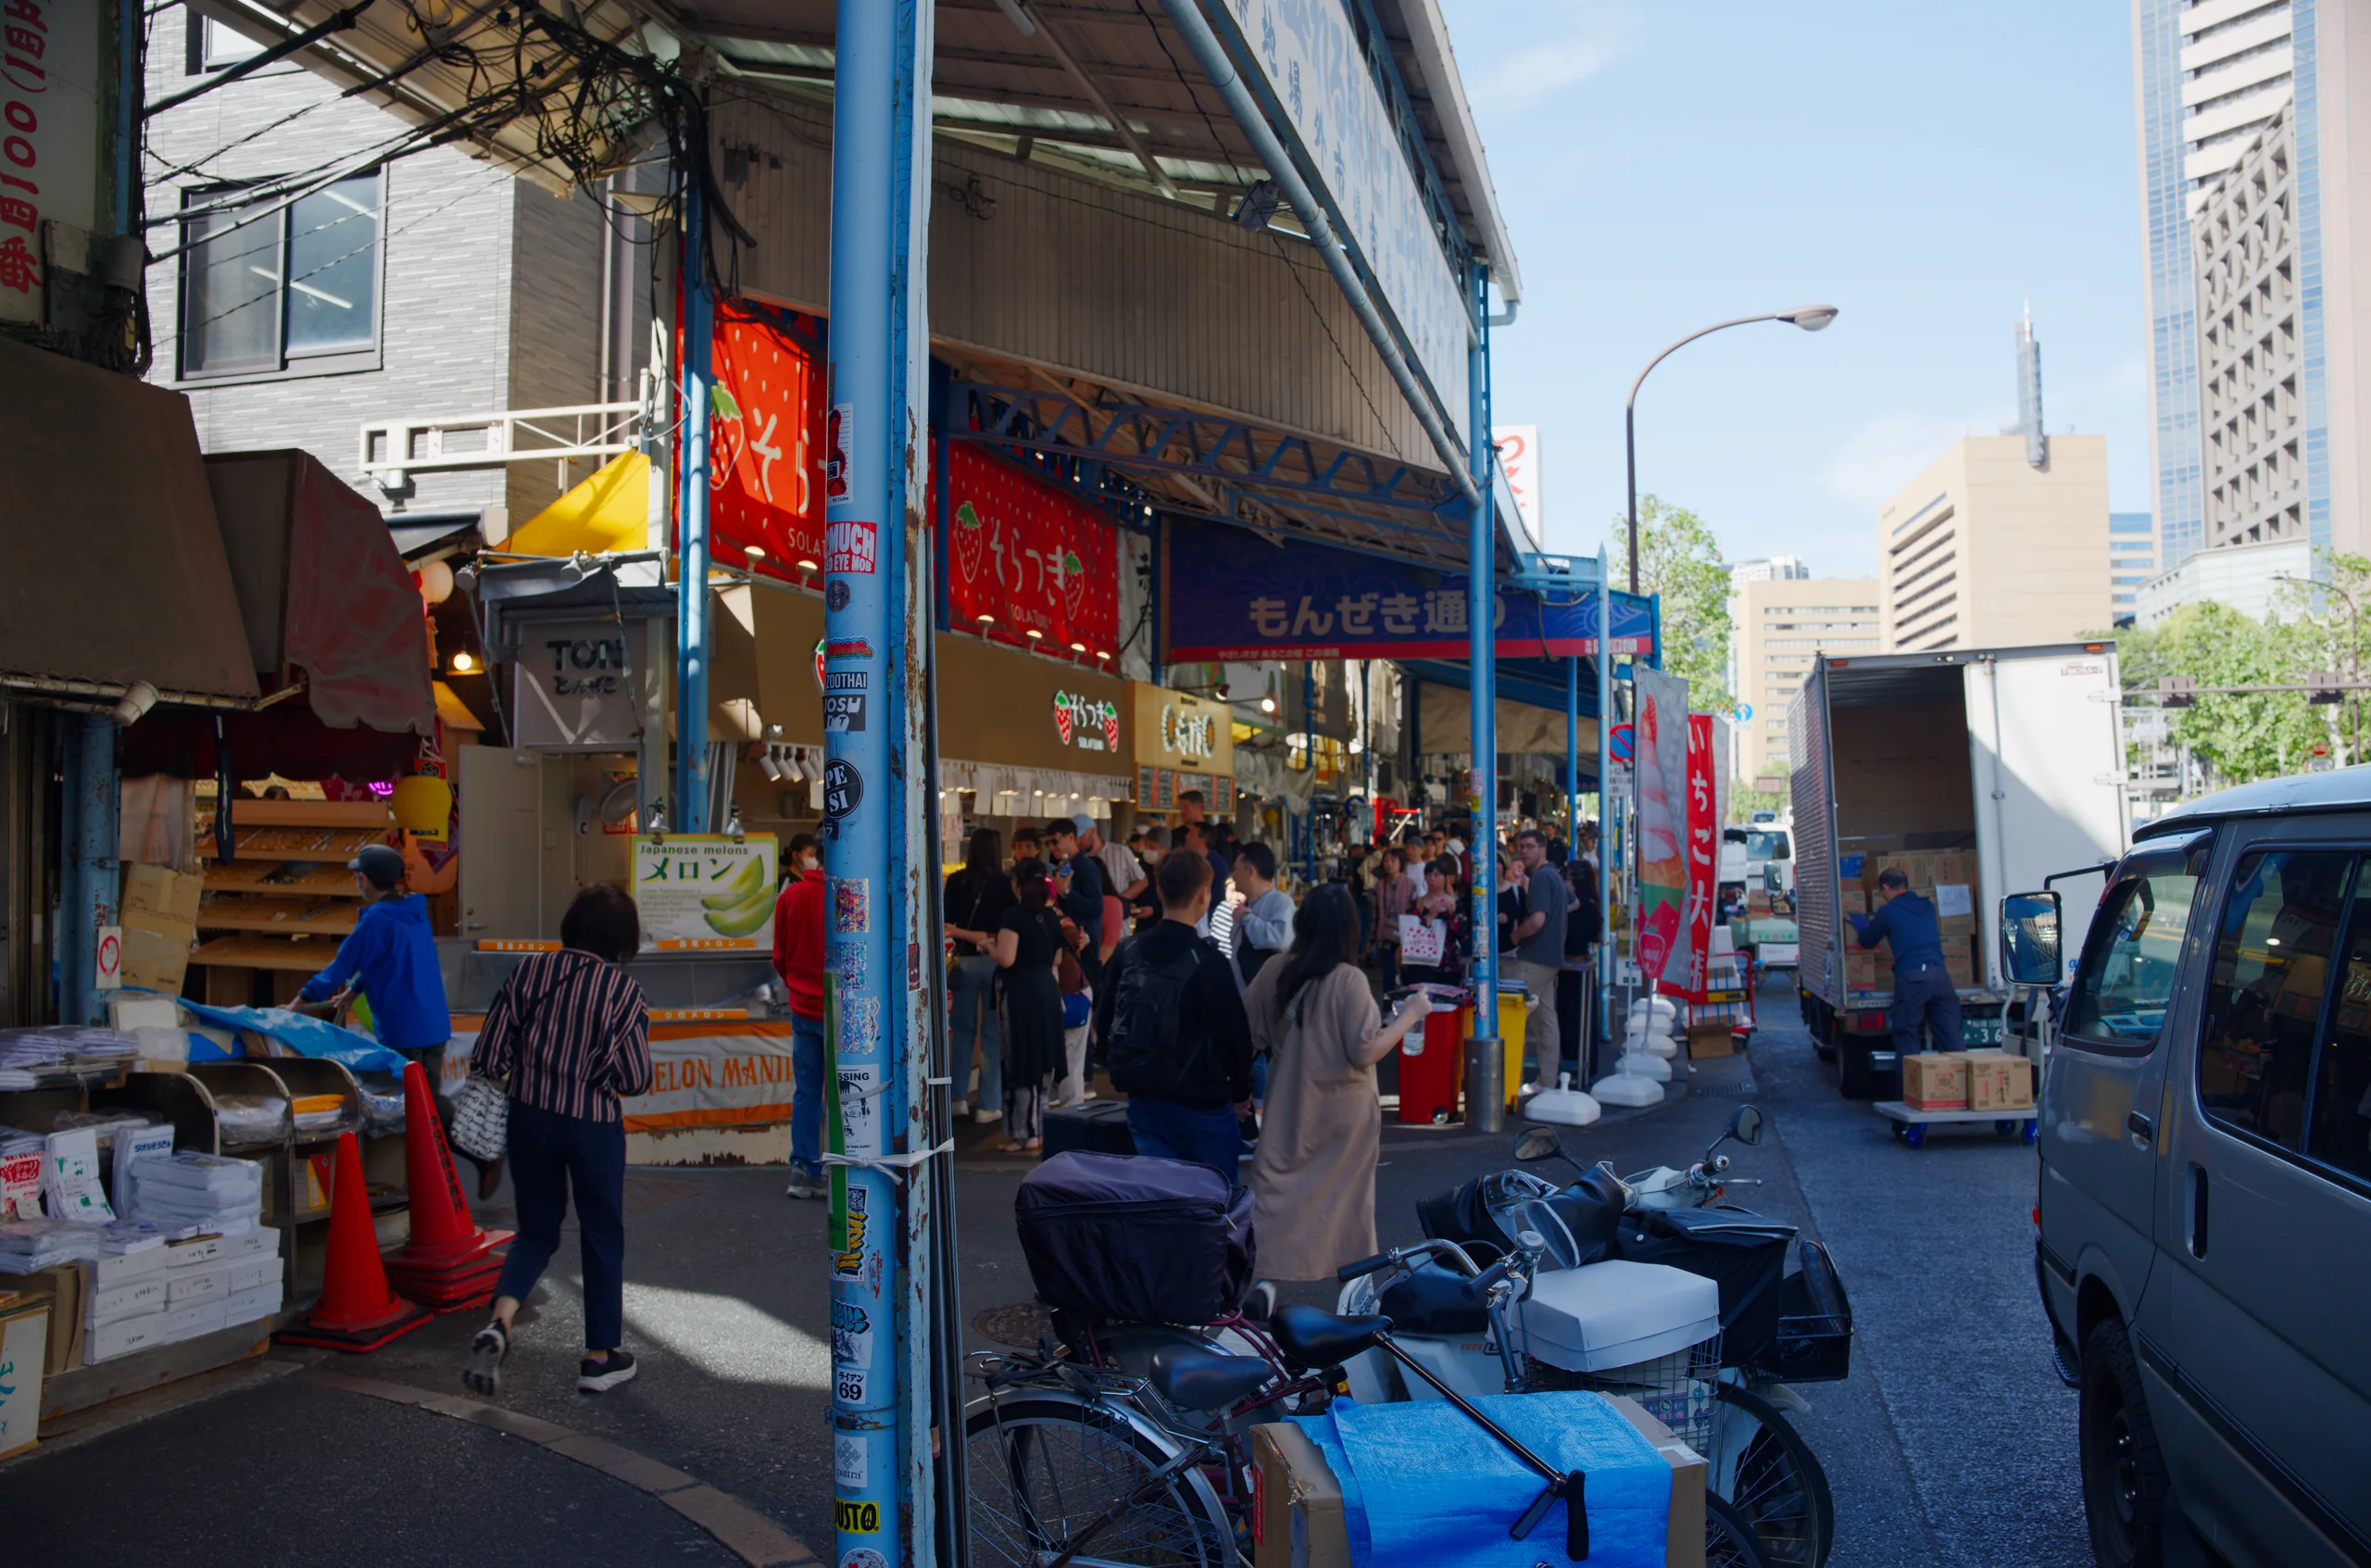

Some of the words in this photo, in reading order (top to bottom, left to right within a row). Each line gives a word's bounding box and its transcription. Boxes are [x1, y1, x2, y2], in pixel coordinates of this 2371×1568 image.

[826, 522, 874, 562] MUCH
[834, 553, 849, 571] EYE
[851, 555, 872, 572] MOB
[989, 519, 1066, 607] そらつき
[1071, 693, 1104, 731] そらつき
[640, 845, 697, 856] Japanese
[704, 845, 748, 855] melons
[640, 857, 735, 882] メロン
[648, 1059, 712, 1097] ELON
[838, 1371, 864, 1383] ライアン
[838, 1382, 862, 1400] 69
[834, 1501, 877, 1532] USTO
